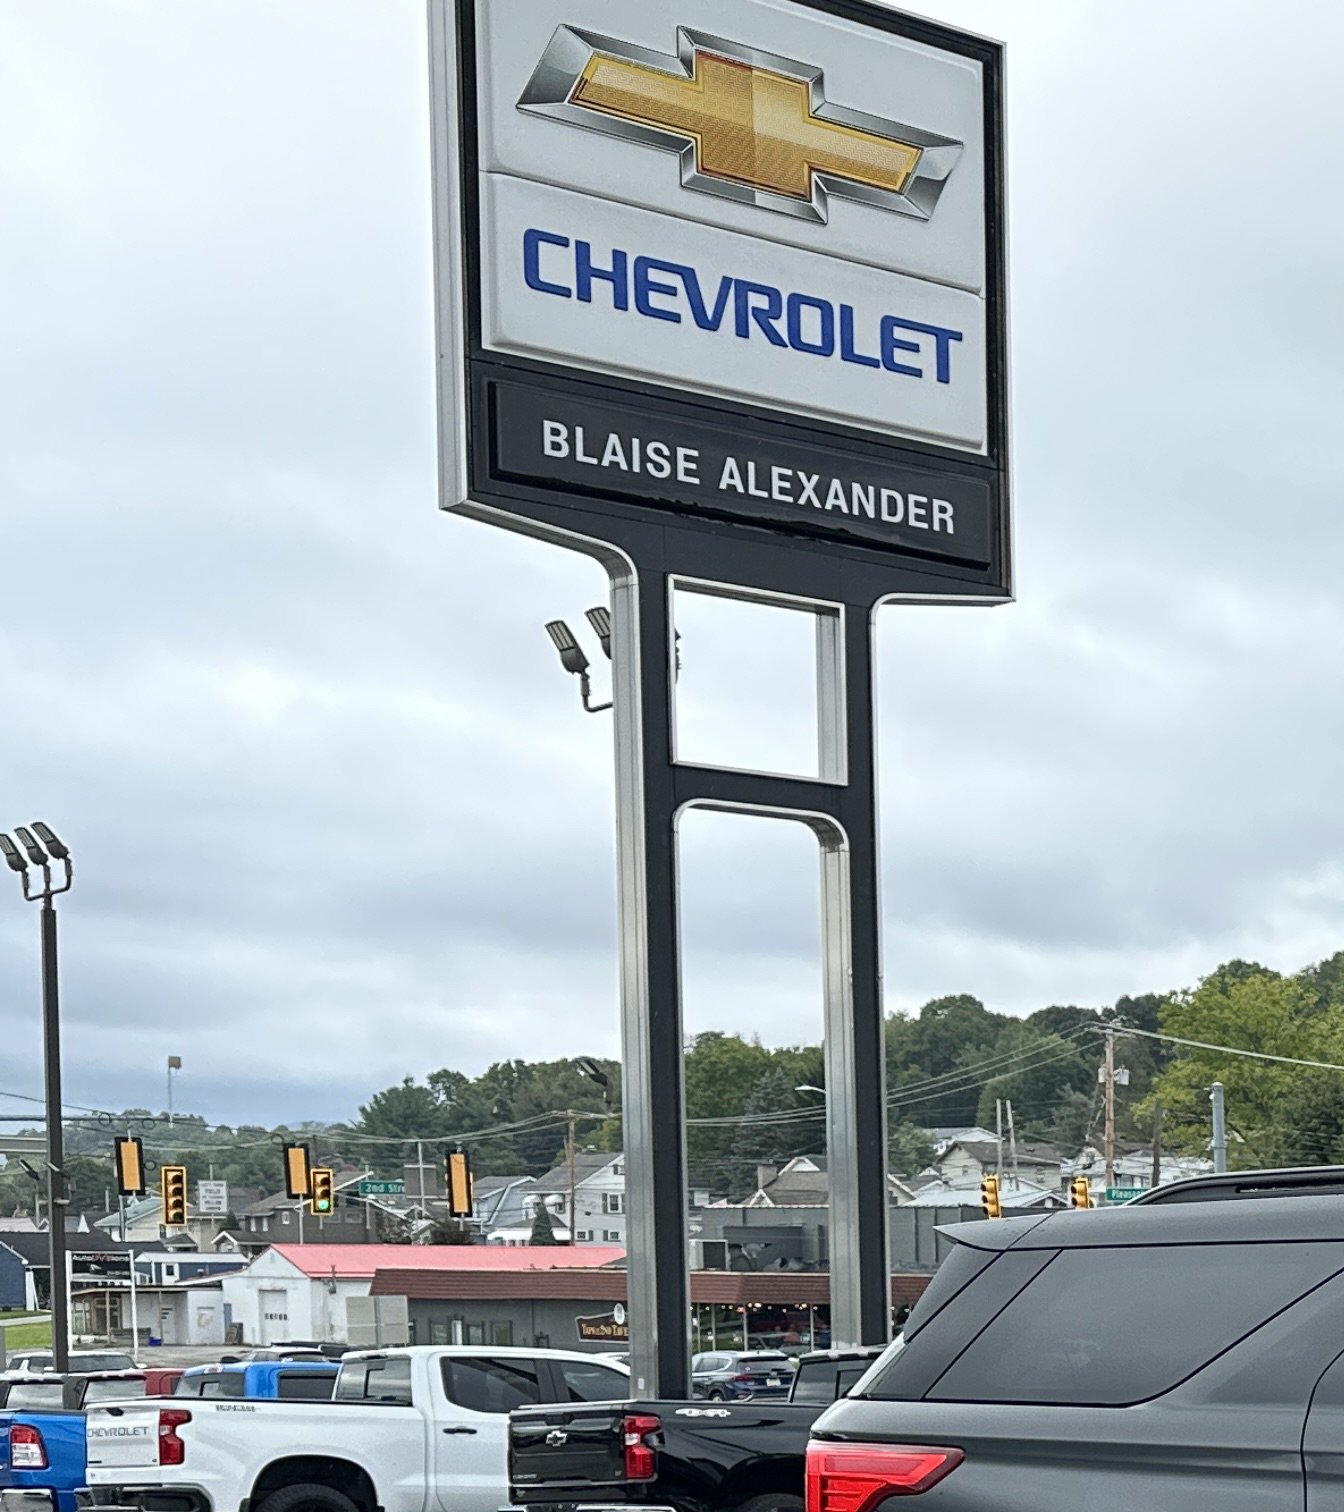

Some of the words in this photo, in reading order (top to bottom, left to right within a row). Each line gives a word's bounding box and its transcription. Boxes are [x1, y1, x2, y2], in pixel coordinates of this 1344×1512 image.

[523, 228, 963, 384] CHEVROLET
[542, 419, 700, 484] BLAISE
[719, 456, 955, 534] ALEXANDER
[366, 1184, 385, 1193] 2nd
[87, 1426, 149, 1438] CHEVROLET
